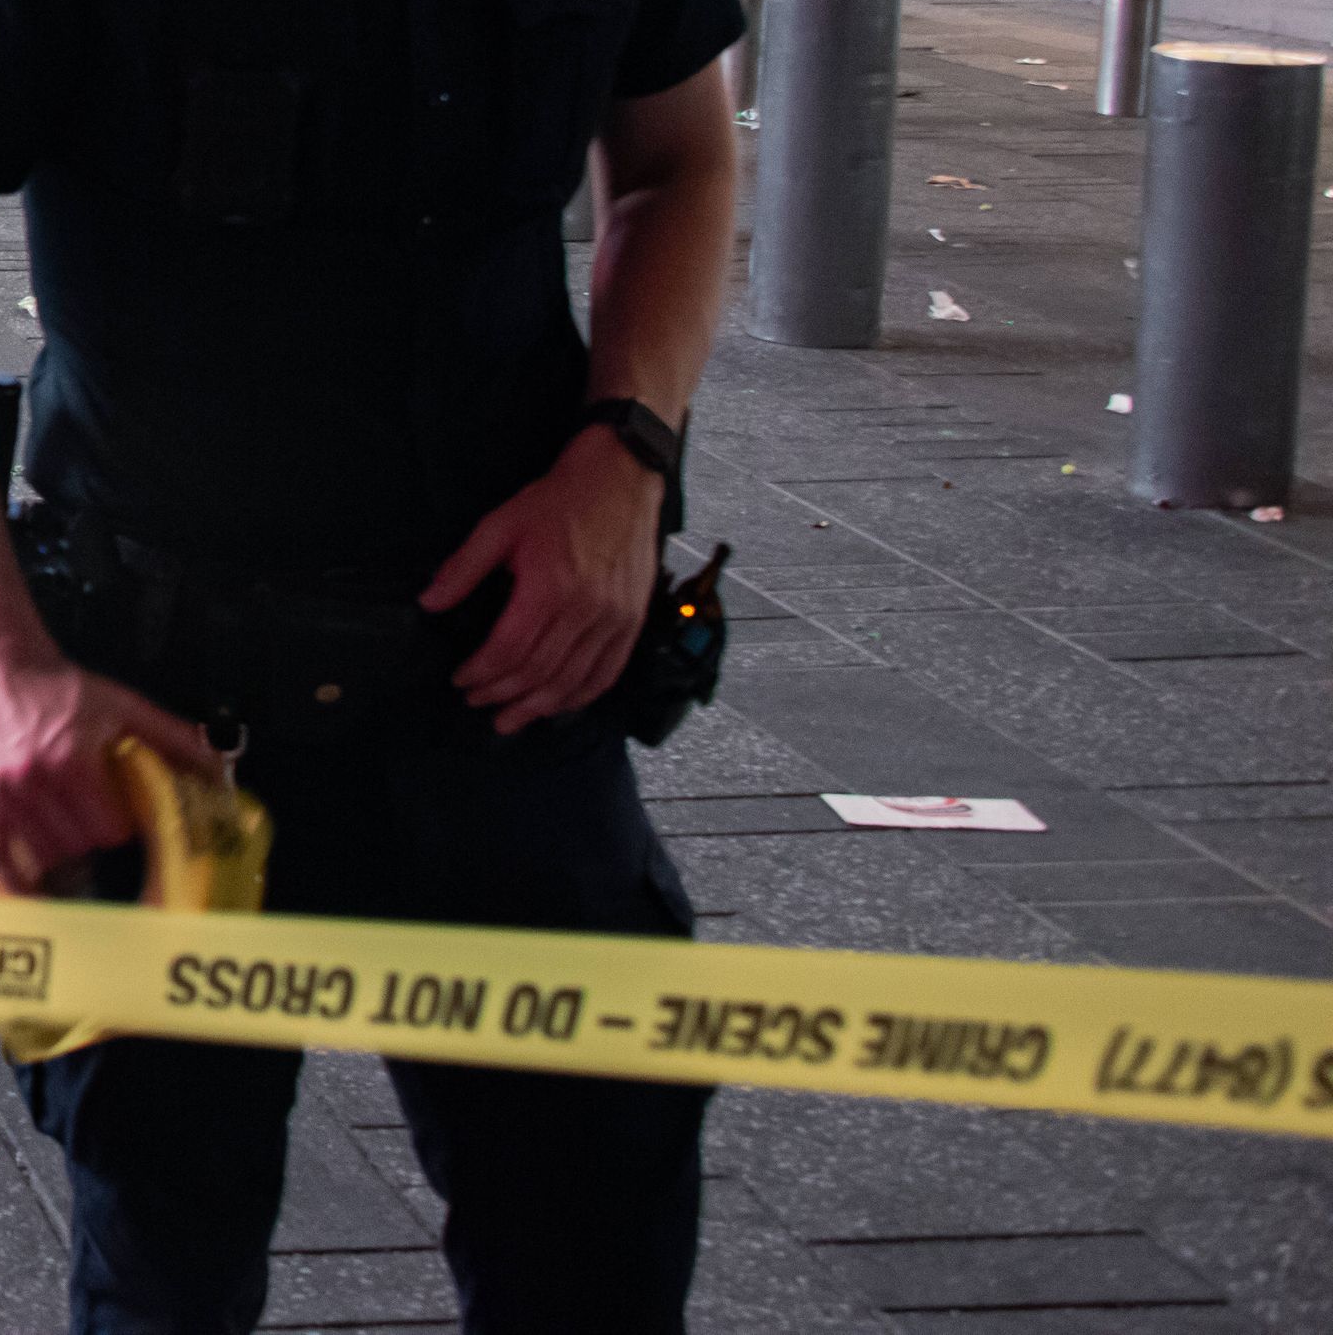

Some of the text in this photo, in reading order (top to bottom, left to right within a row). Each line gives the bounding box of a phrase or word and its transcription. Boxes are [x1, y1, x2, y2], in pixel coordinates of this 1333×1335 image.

[166, 954, 356, 1021] CROSS
[367, 970, 489, 1033] NOT
[502, 983, 586, 1041] DO
[648, 996, 844, 1063] SCENE
[856, 1011, 1050, 1083] CRIME
